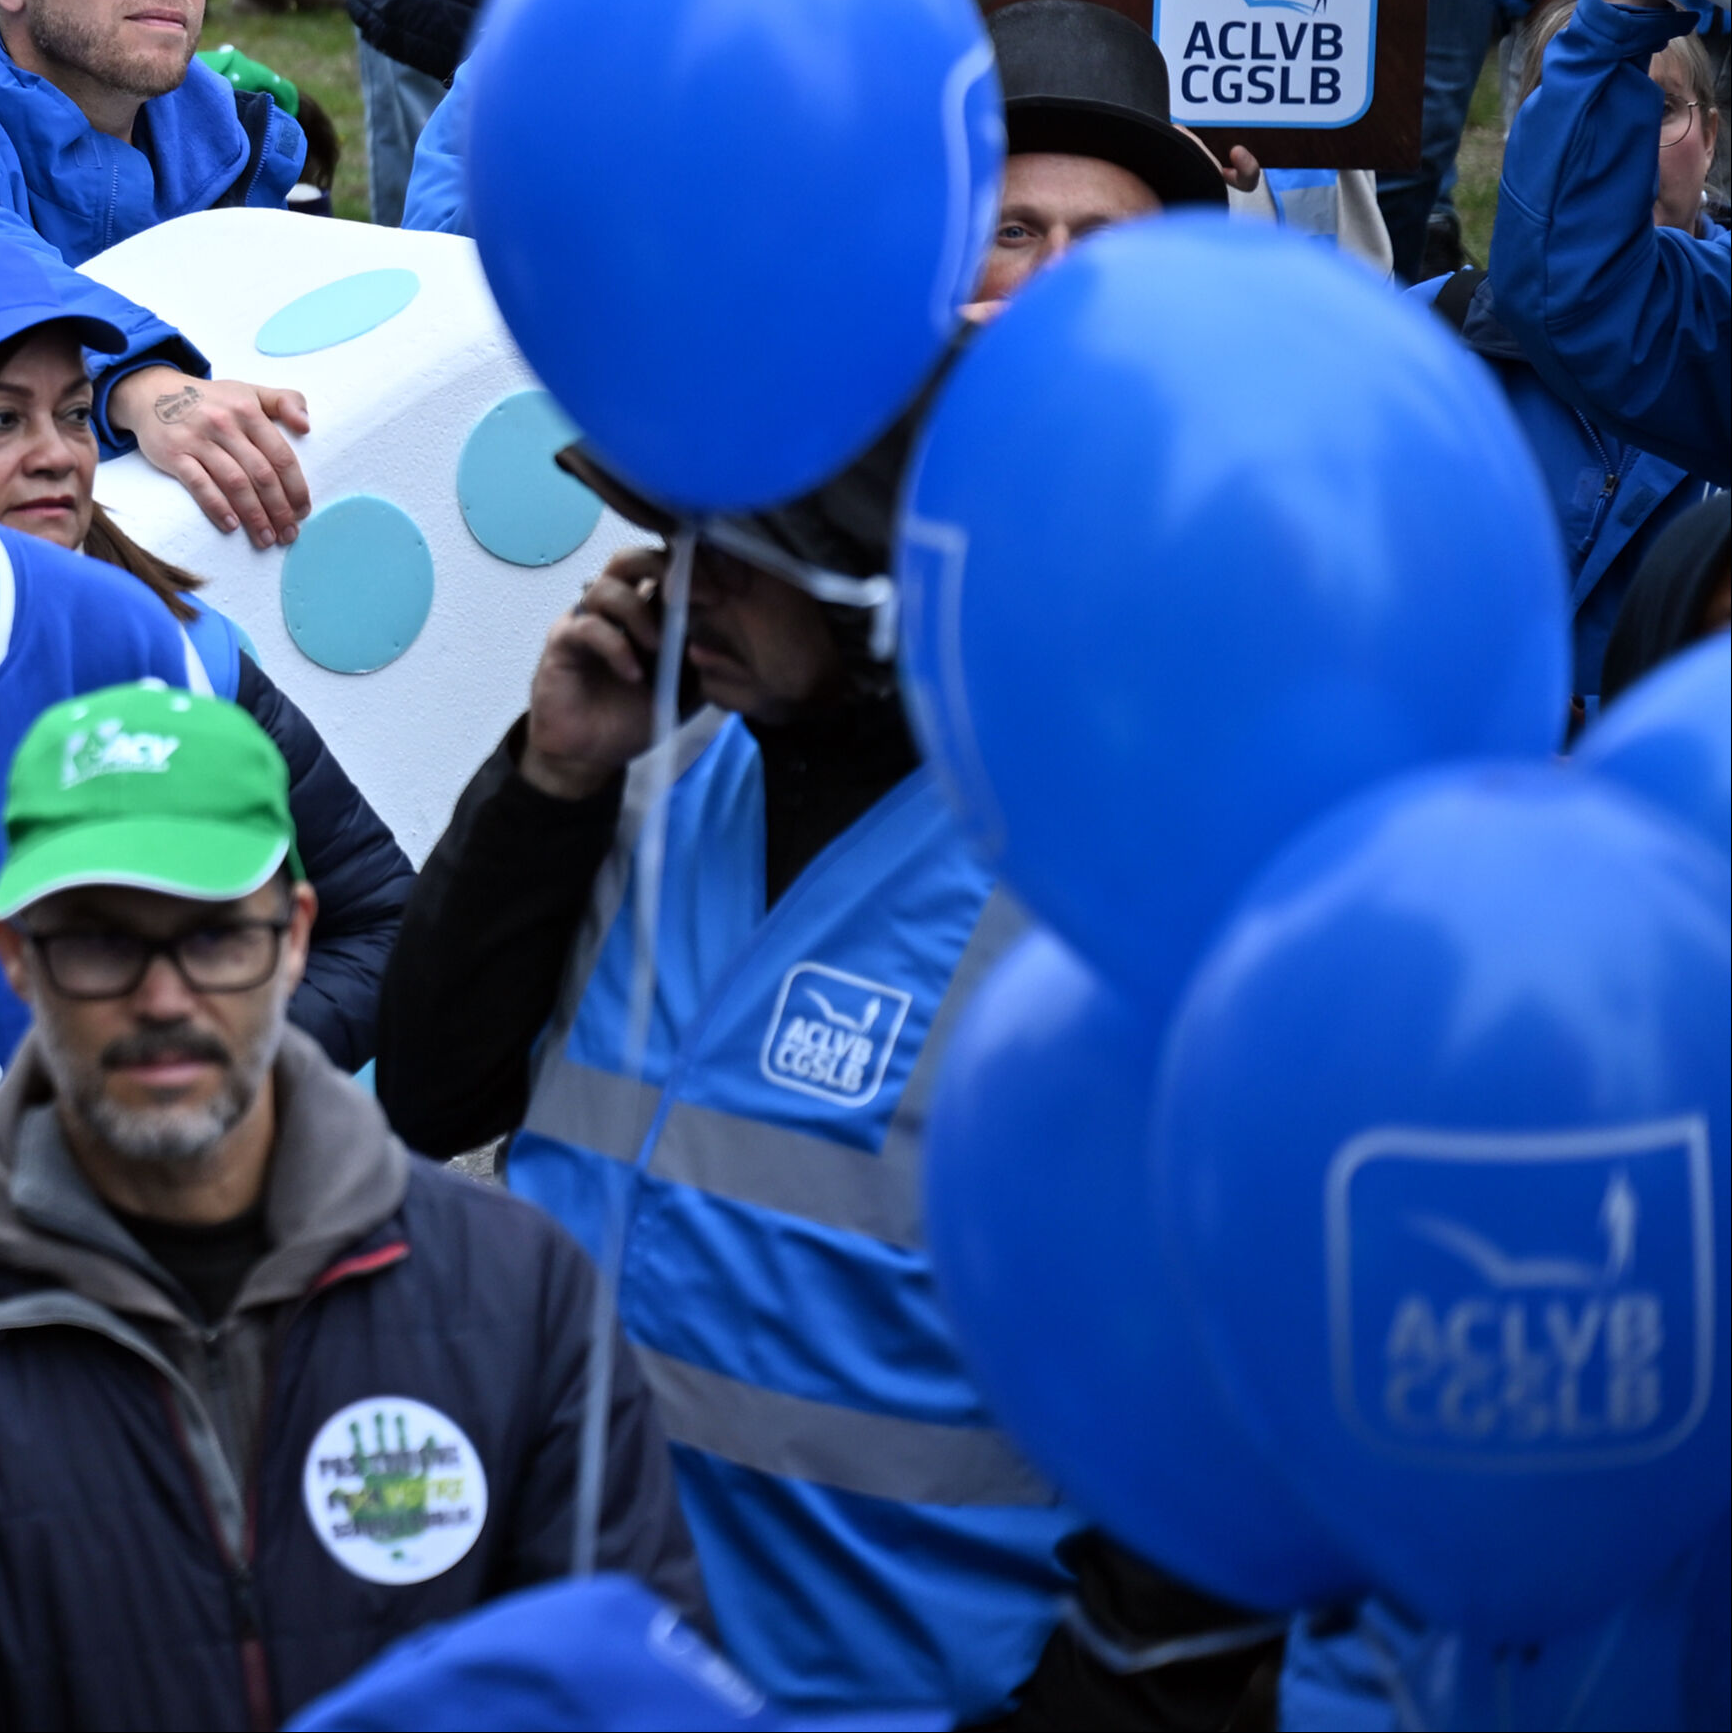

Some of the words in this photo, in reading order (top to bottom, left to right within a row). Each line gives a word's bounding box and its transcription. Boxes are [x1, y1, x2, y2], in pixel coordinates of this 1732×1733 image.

[1183, 20, 1344, 62] ACLVB
[1181, 64, 1342, 106] CGSLB
[785, 1016, 874, 1066] ACLVB
[775, 1043, 864, 1093] CGSLB
[1385, 1290, 1663, 1366] ACLVB
